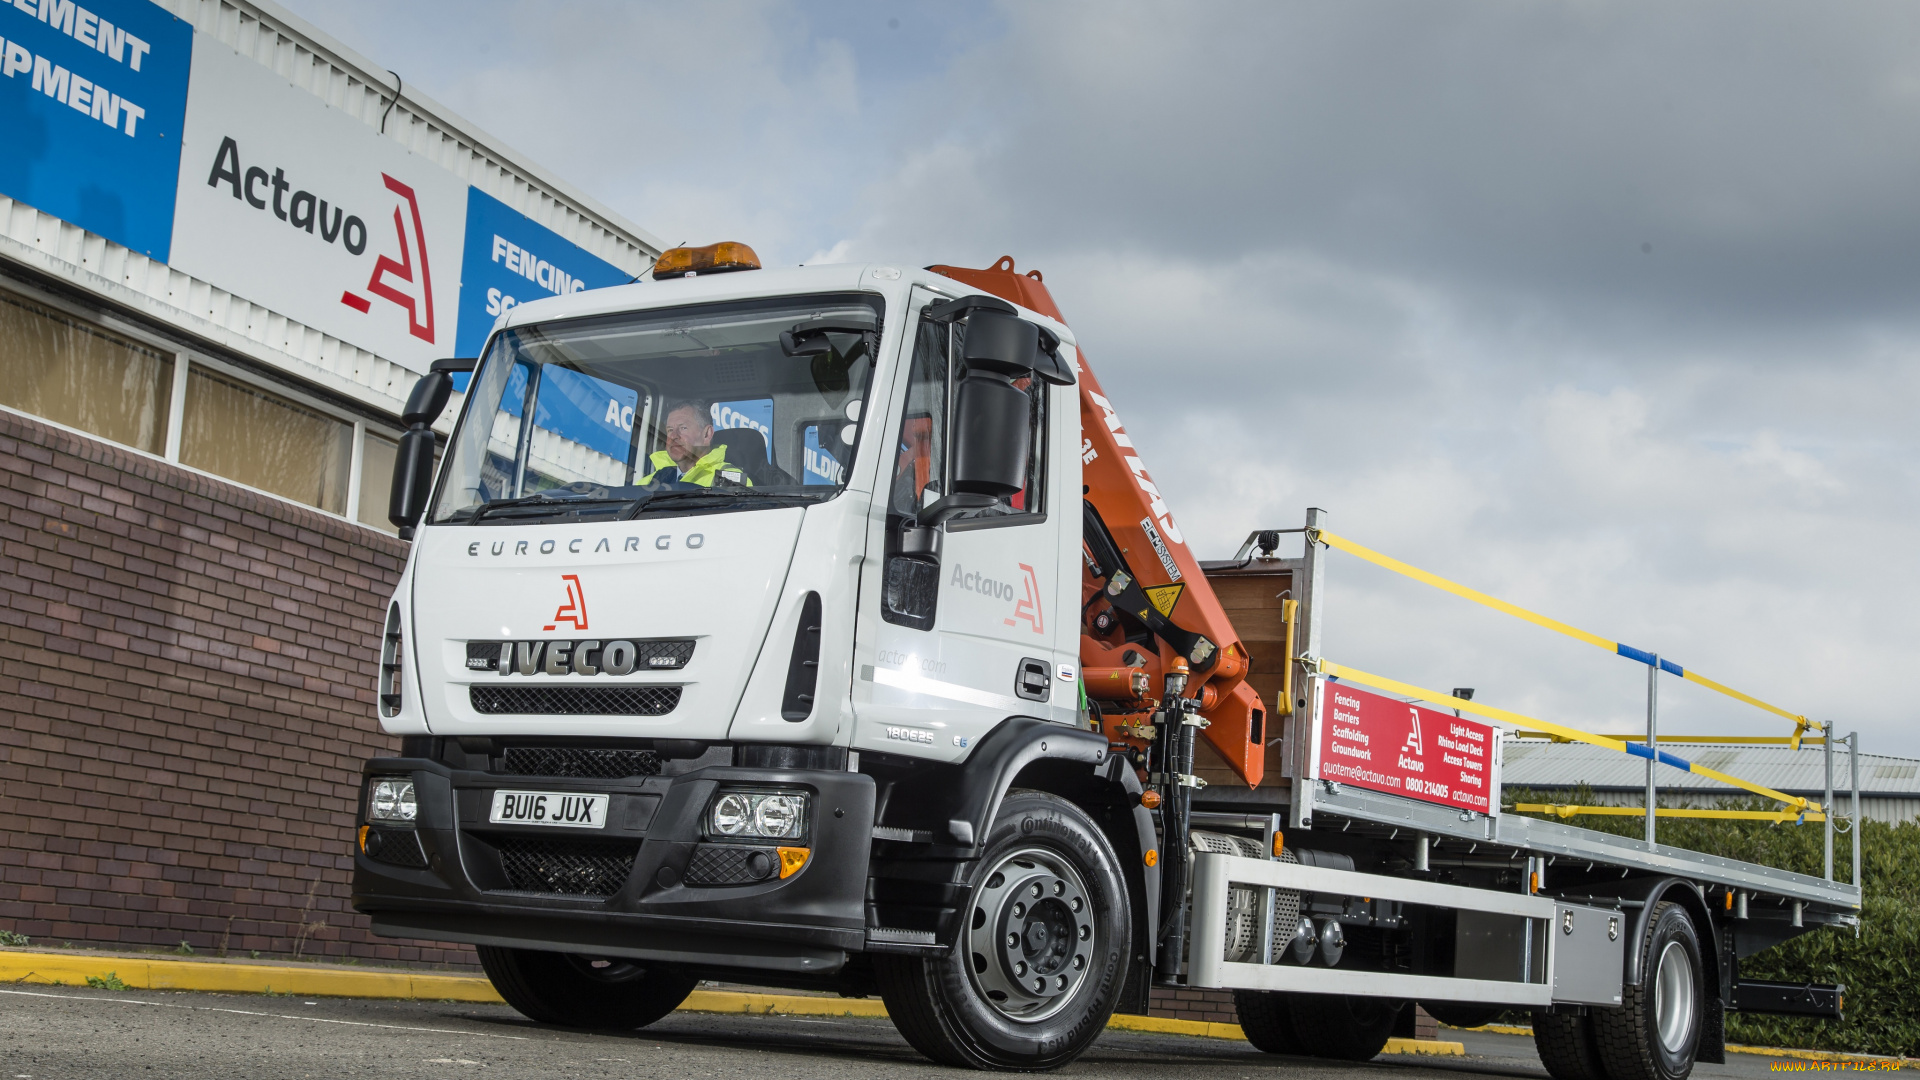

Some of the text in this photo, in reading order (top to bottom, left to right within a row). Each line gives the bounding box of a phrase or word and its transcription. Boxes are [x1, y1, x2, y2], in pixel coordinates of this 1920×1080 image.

[0, 0, 151, 72] MENT
[208, 136, 368, 257] Actavo
[605, 399, 635, 433] AC
[468, 532, 705, 557] EUROCARGO
[950, 563, 1014, 602] Actavo
[498, 639, 642, 677] IVECO
[1334, 692, 1360, 711] Fencing
[1333, 708, 1359, 725] Barriers
[886, 727, 934, 744] 180E25
[1332, 725, 1369, 746] Scaffolding
[1450, 723, 1484, 742] Light Access
[1331, 741, 1371, 760] Groundwork
[1438, 735, 1483, 757] Rhino Load Deck
[1398, 754, 1424, 772] Actavo
[1443, 752, 1483, 771] Access Towers
[1323, 762, 1488, 807] quoteme@actavo.com 0800 214005 actavo.com
[502, 795, 595, 822] BU16 JUX
[1021, 816, 1094, 856] Continental
[1063, 998, 1103, 1046] Hybrid
